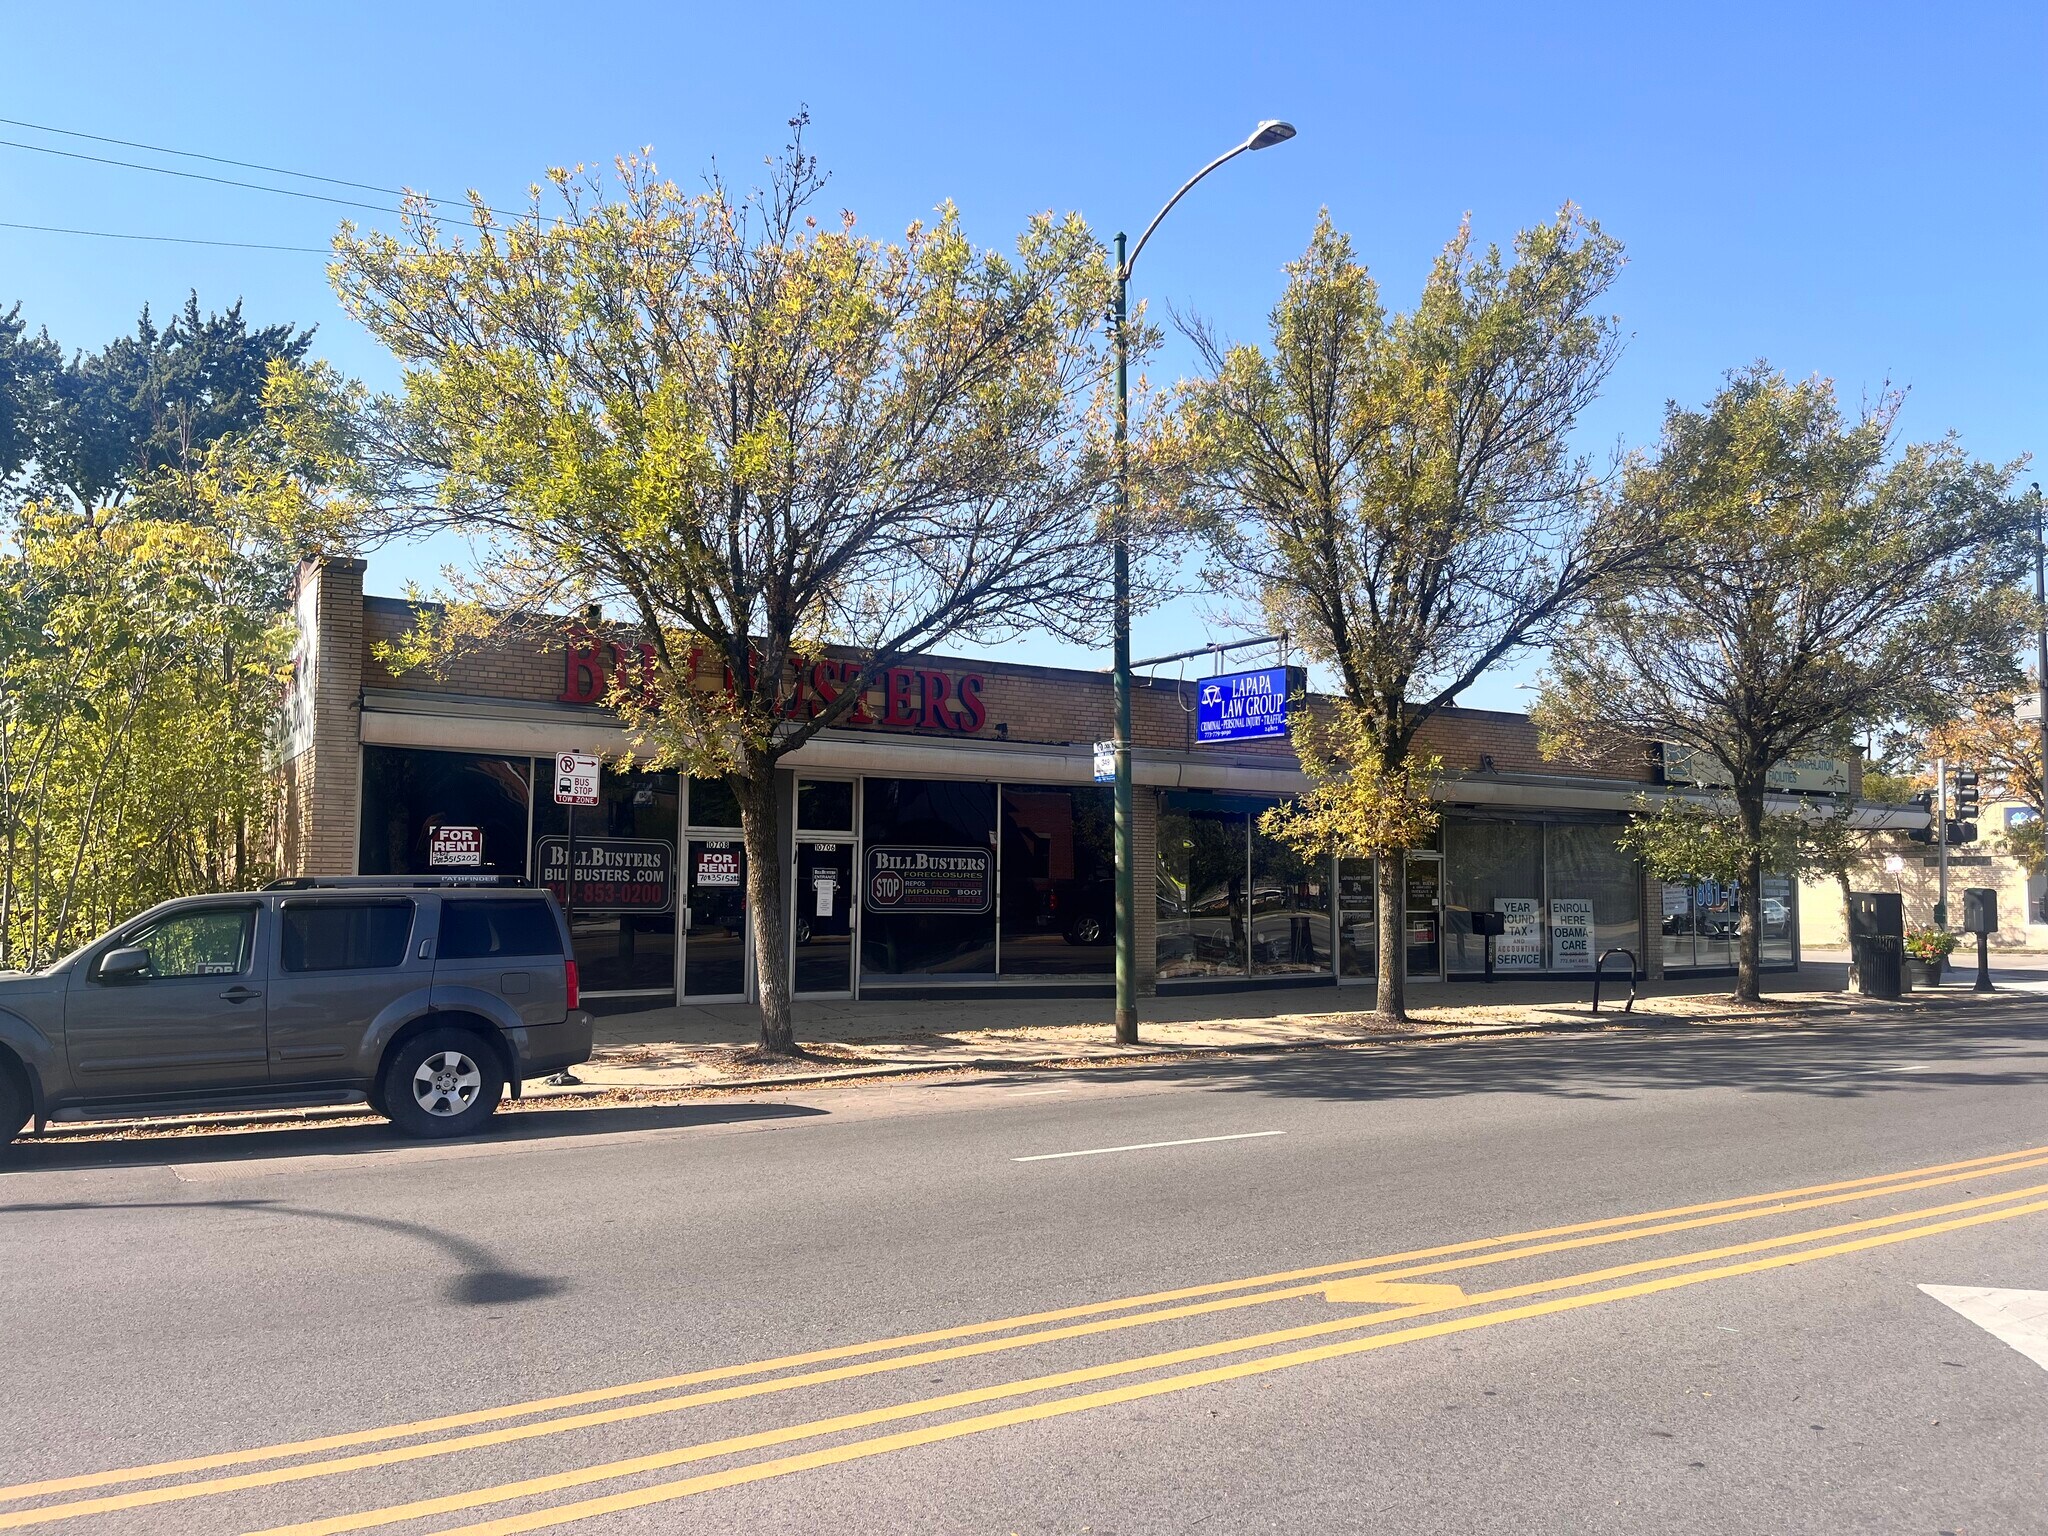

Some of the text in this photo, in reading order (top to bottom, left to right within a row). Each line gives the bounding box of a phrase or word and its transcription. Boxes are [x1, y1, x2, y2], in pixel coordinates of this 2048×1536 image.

[1232, 675, 1271, 698] LAPAPA
[1221, 693, 1284, 718] LAW GROUP
[1264, 713, 1283, 725] TRAFFIC
[574, 778, 590, 787] BUS
[1768, 772, 1797, 783] FACILITIES
[574, 786, 593, 795] STOP
[558, 795, 573, 803] TOW
[440, 830, 474, 841] FOR
[434, 841, 479, 852] RENT
[706, 841, 730, 849] 10708
[703, 853, 734, 864] FOR
[698, 863, 738, 874] RENT
[904, 871, 983, 879] FORECLOSURES
[876, 878, 900, 898] STOP
[1504, 902, 1531, 913] YEAR
[1553, 903, 1590, 913] ENROLL
[1503, 914, 1535, 925] OUND
[1561, 915, 1586, 925] HERE
[1509, 926, 1528, 936] TAX
[1554, 928, 1593, 938] OBAMA-
[1498, 945, 1540, 953] ACCOUNTING
[1562, 940, 1587, 950] CARE
[1497, 954, 1540, 965] SERVICE
